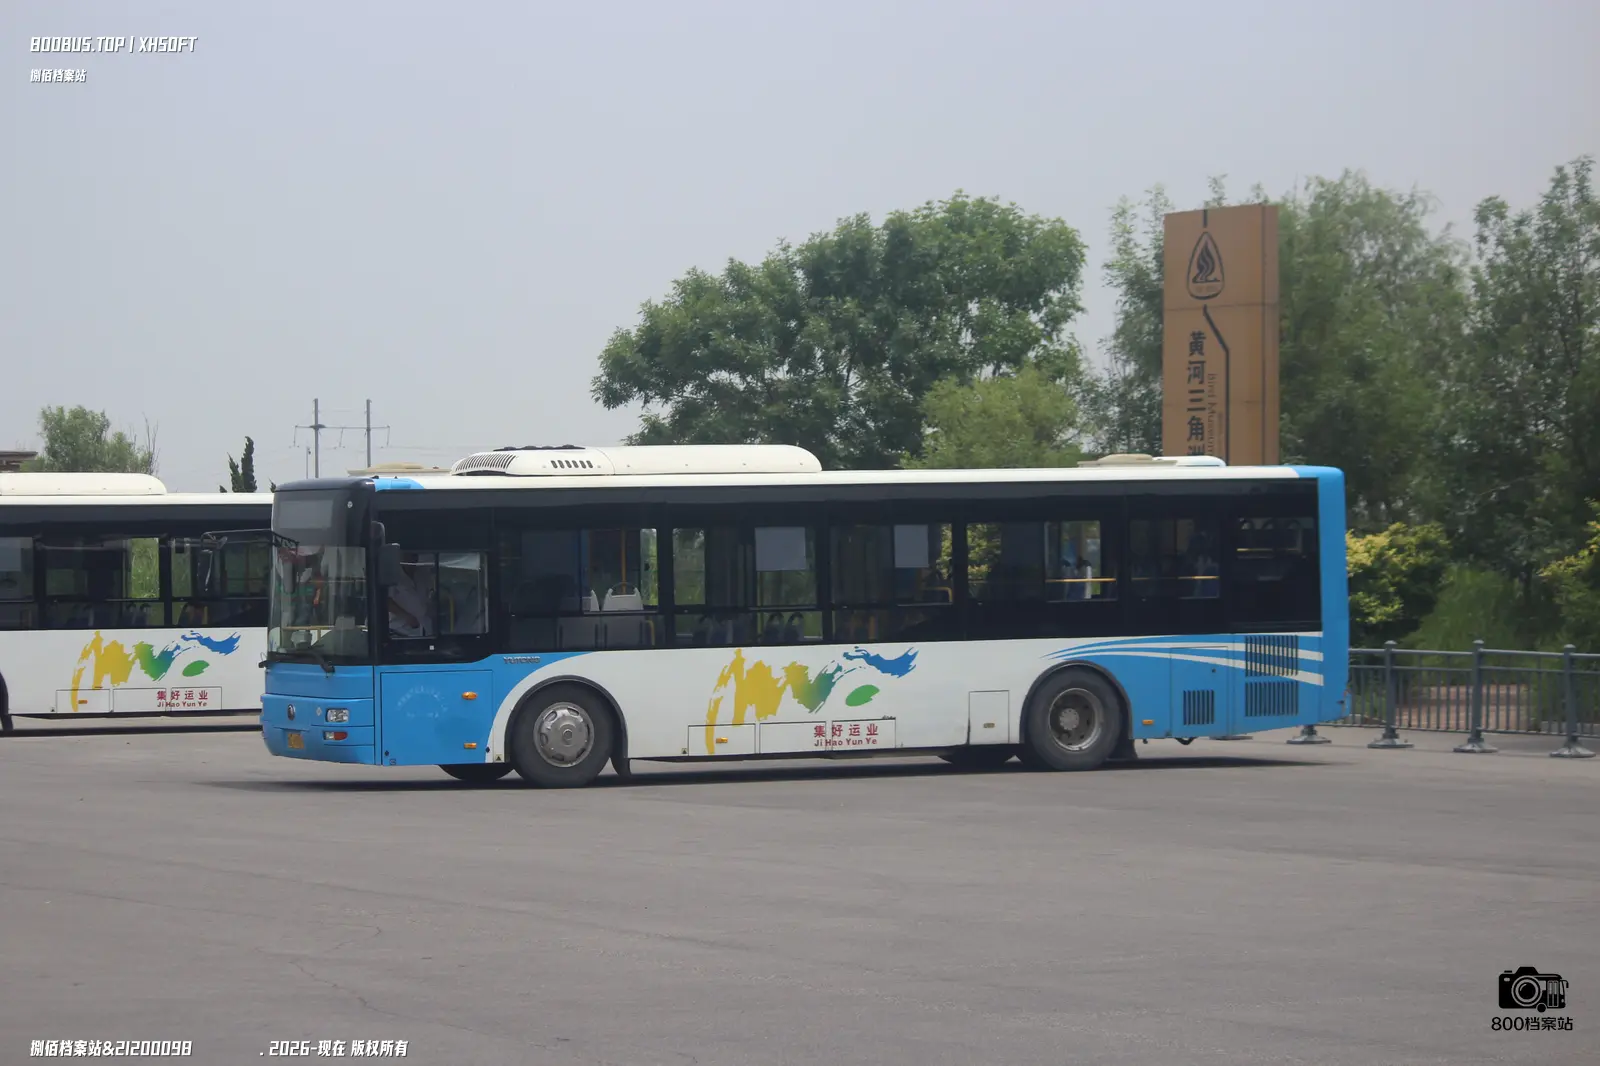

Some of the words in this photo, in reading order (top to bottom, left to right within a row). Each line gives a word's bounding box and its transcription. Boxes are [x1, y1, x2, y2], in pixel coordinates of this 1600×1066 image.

[156, 690, 208, 700] 集好运业
[814, 723, 879, 738] 集好运业
[814, 738, 823, 747] Ji
[825, 738, 843, 747] Hao
[845, 738, 863, 746] Yun
[865, 737, 877, 745] Ye
